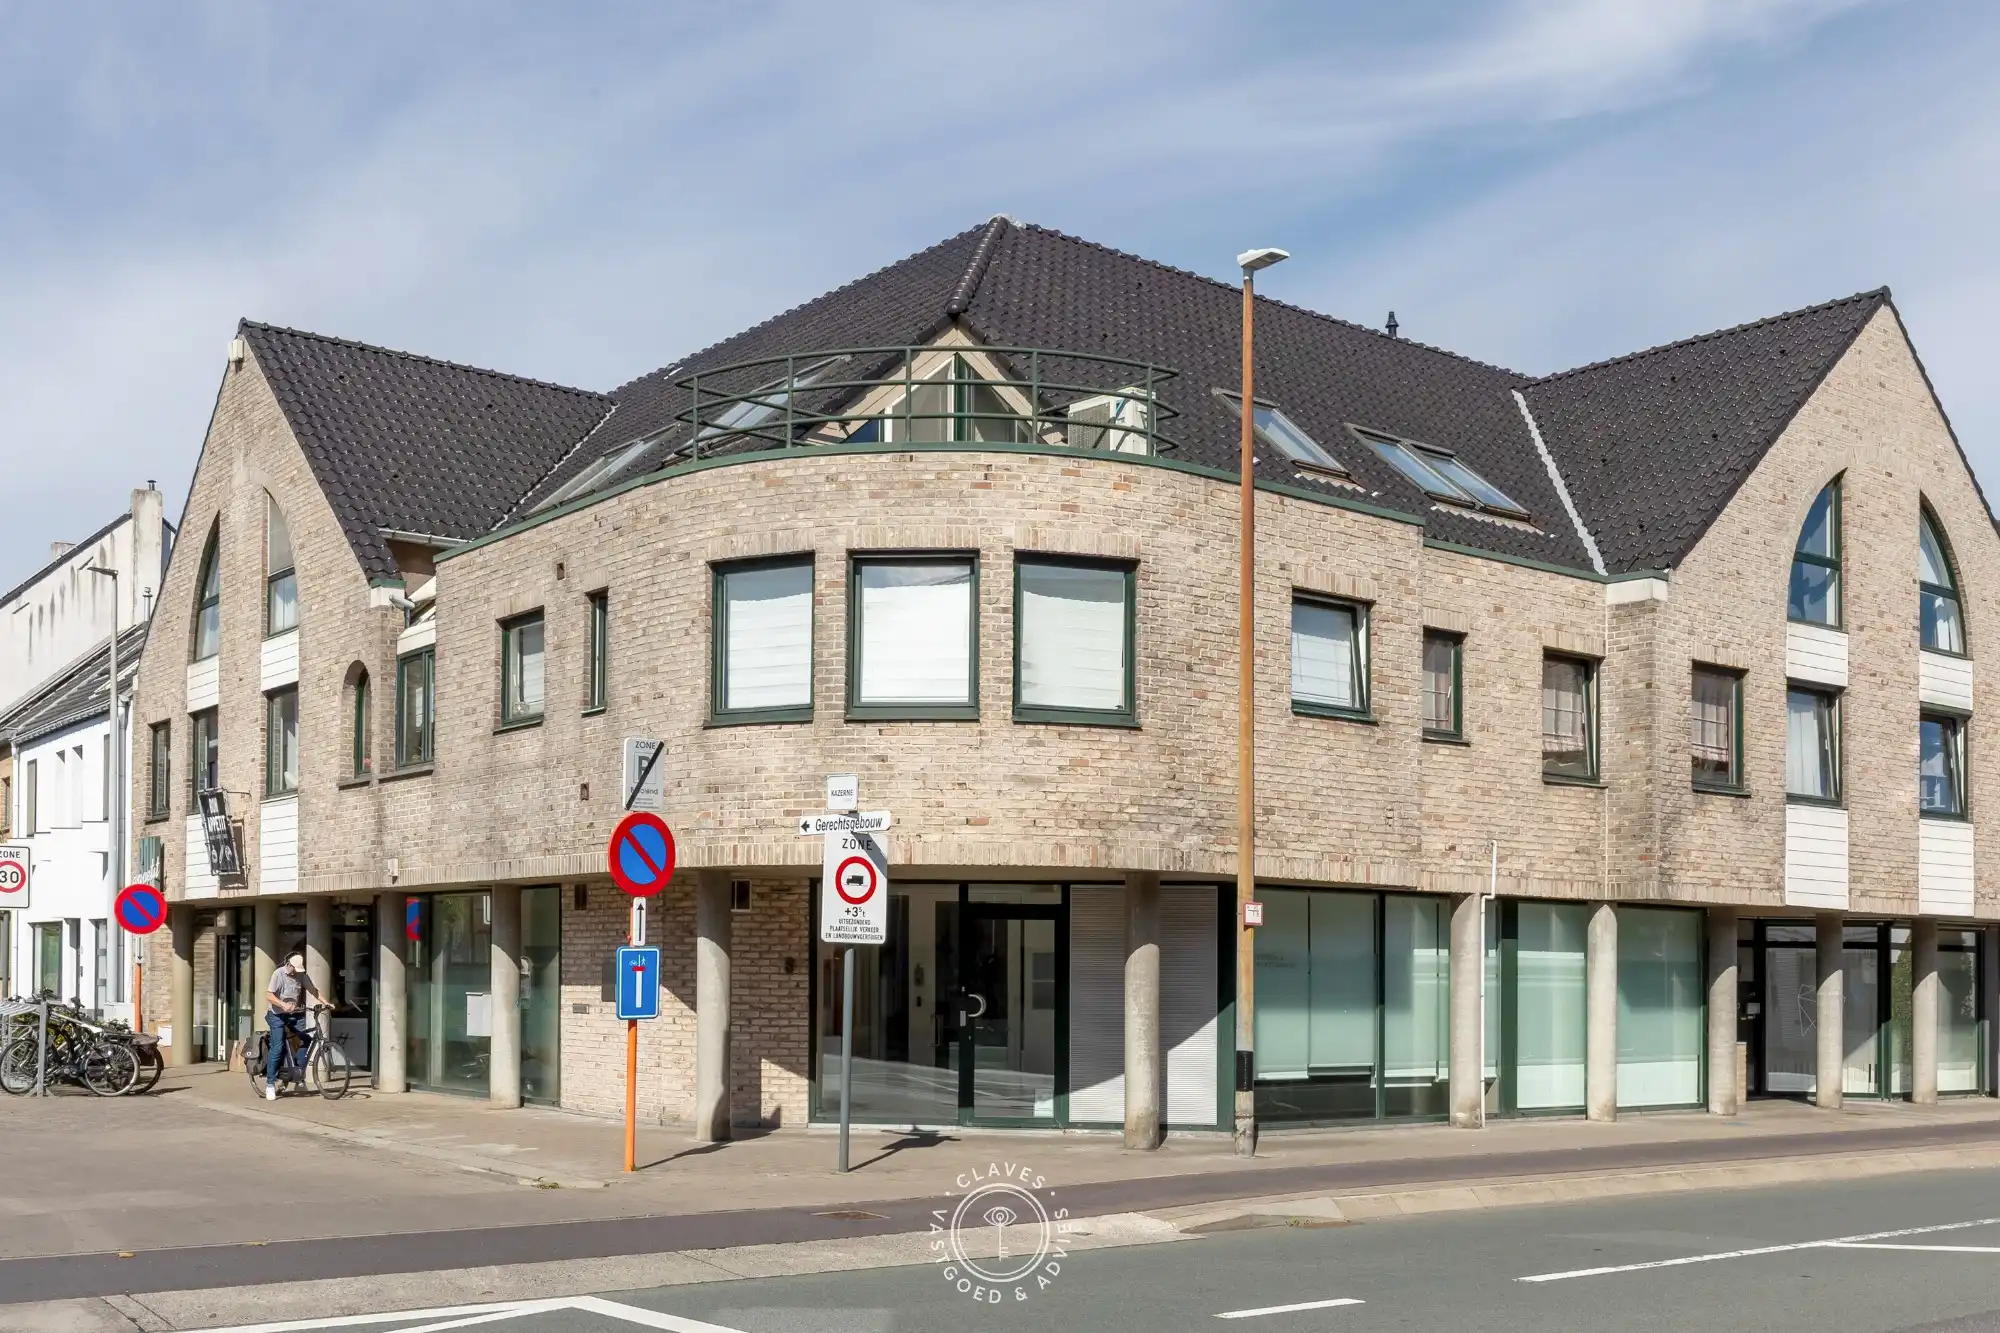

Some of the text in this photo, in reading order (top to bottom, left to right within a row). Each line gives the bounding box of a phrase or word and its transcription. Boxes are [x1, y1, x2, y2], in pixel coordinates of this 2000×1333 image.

[635, 741, 656, 750] ZONE
[630, 786, 659, 795] Balend
[830, 789, 853, 797] KAZERNE
[815, 816, 883, 832] Gerechtsgebouw
[841, 838, 873, 851] ZONE
[0, 870, 19, 883] 30
[838, 918, 871, 926] UITGEZONDERD
